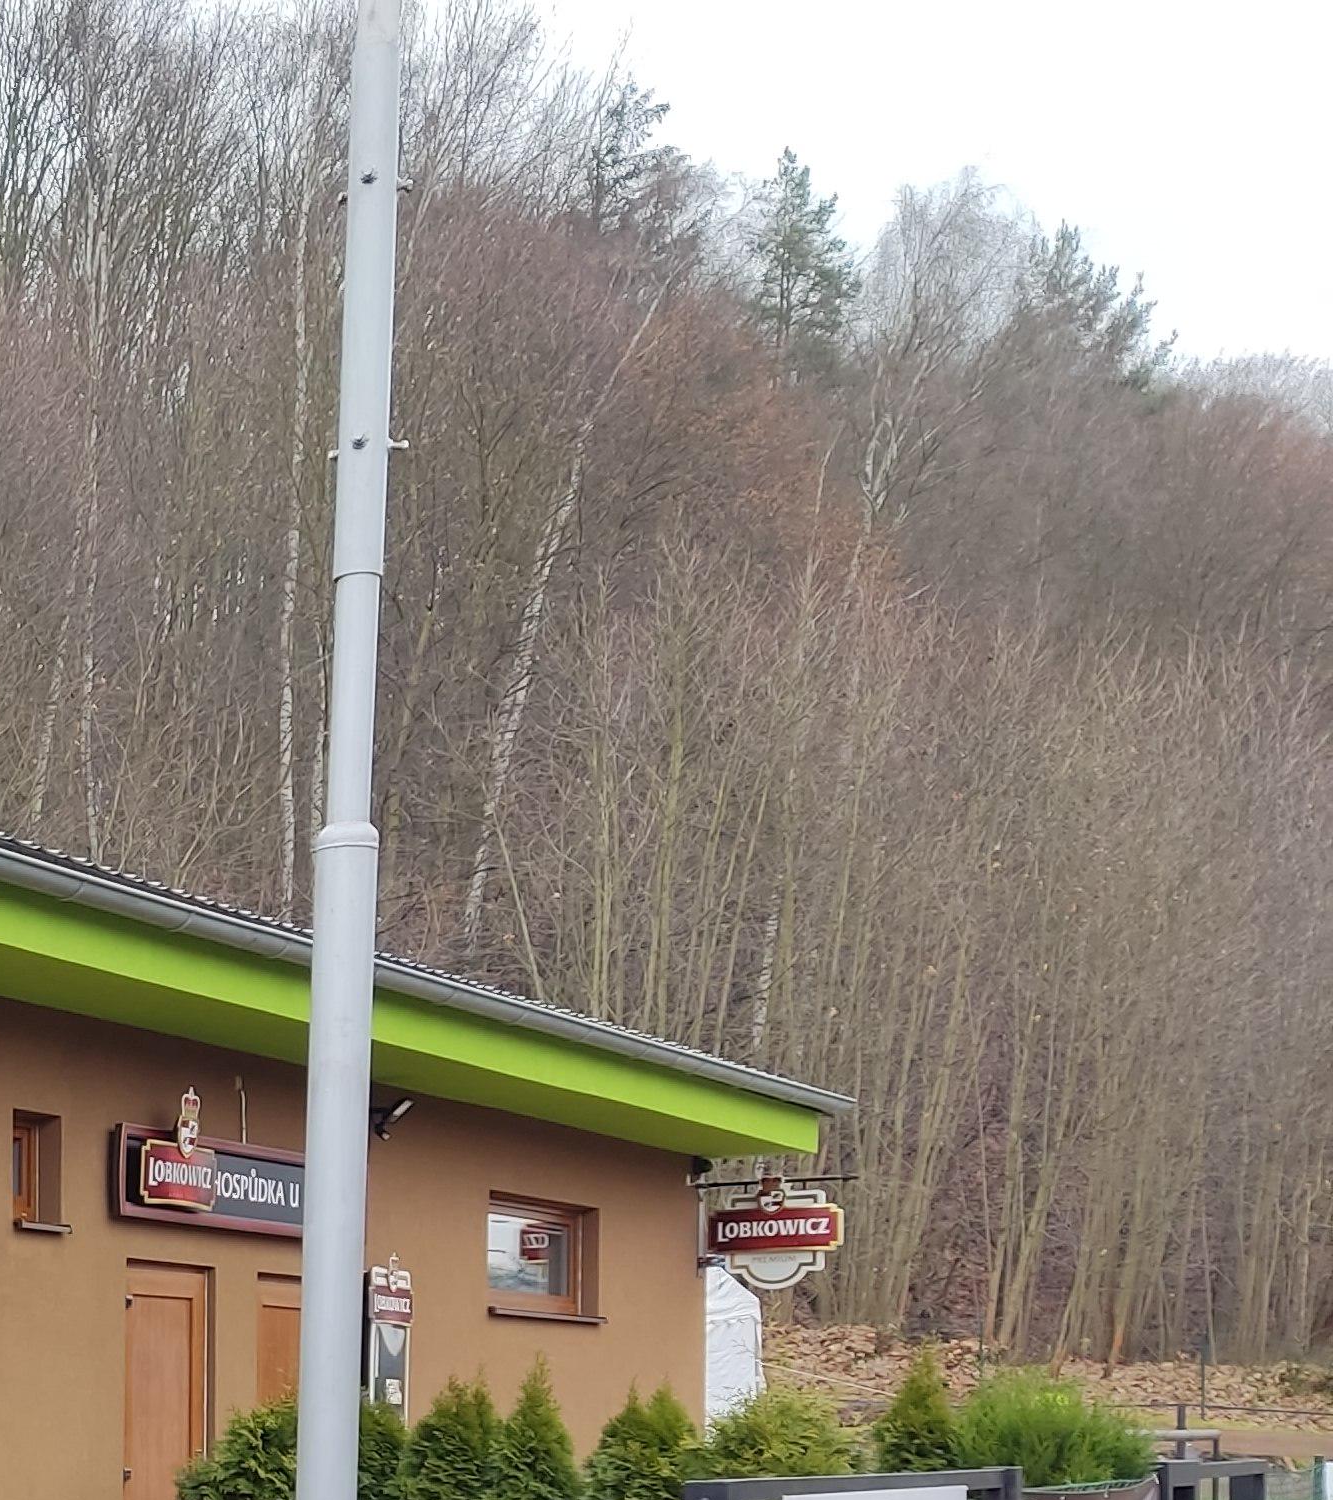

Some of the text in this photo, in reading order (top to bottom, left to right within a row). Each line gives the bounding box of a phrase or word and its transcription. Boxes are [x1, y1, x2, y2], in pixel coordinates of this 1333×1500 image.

[148, 1156, 212, 1189] LOBKOWICZ
[289, 1182, 300, 1208] U
[717, 1217, 831, 1242] LOBKOWICZ
